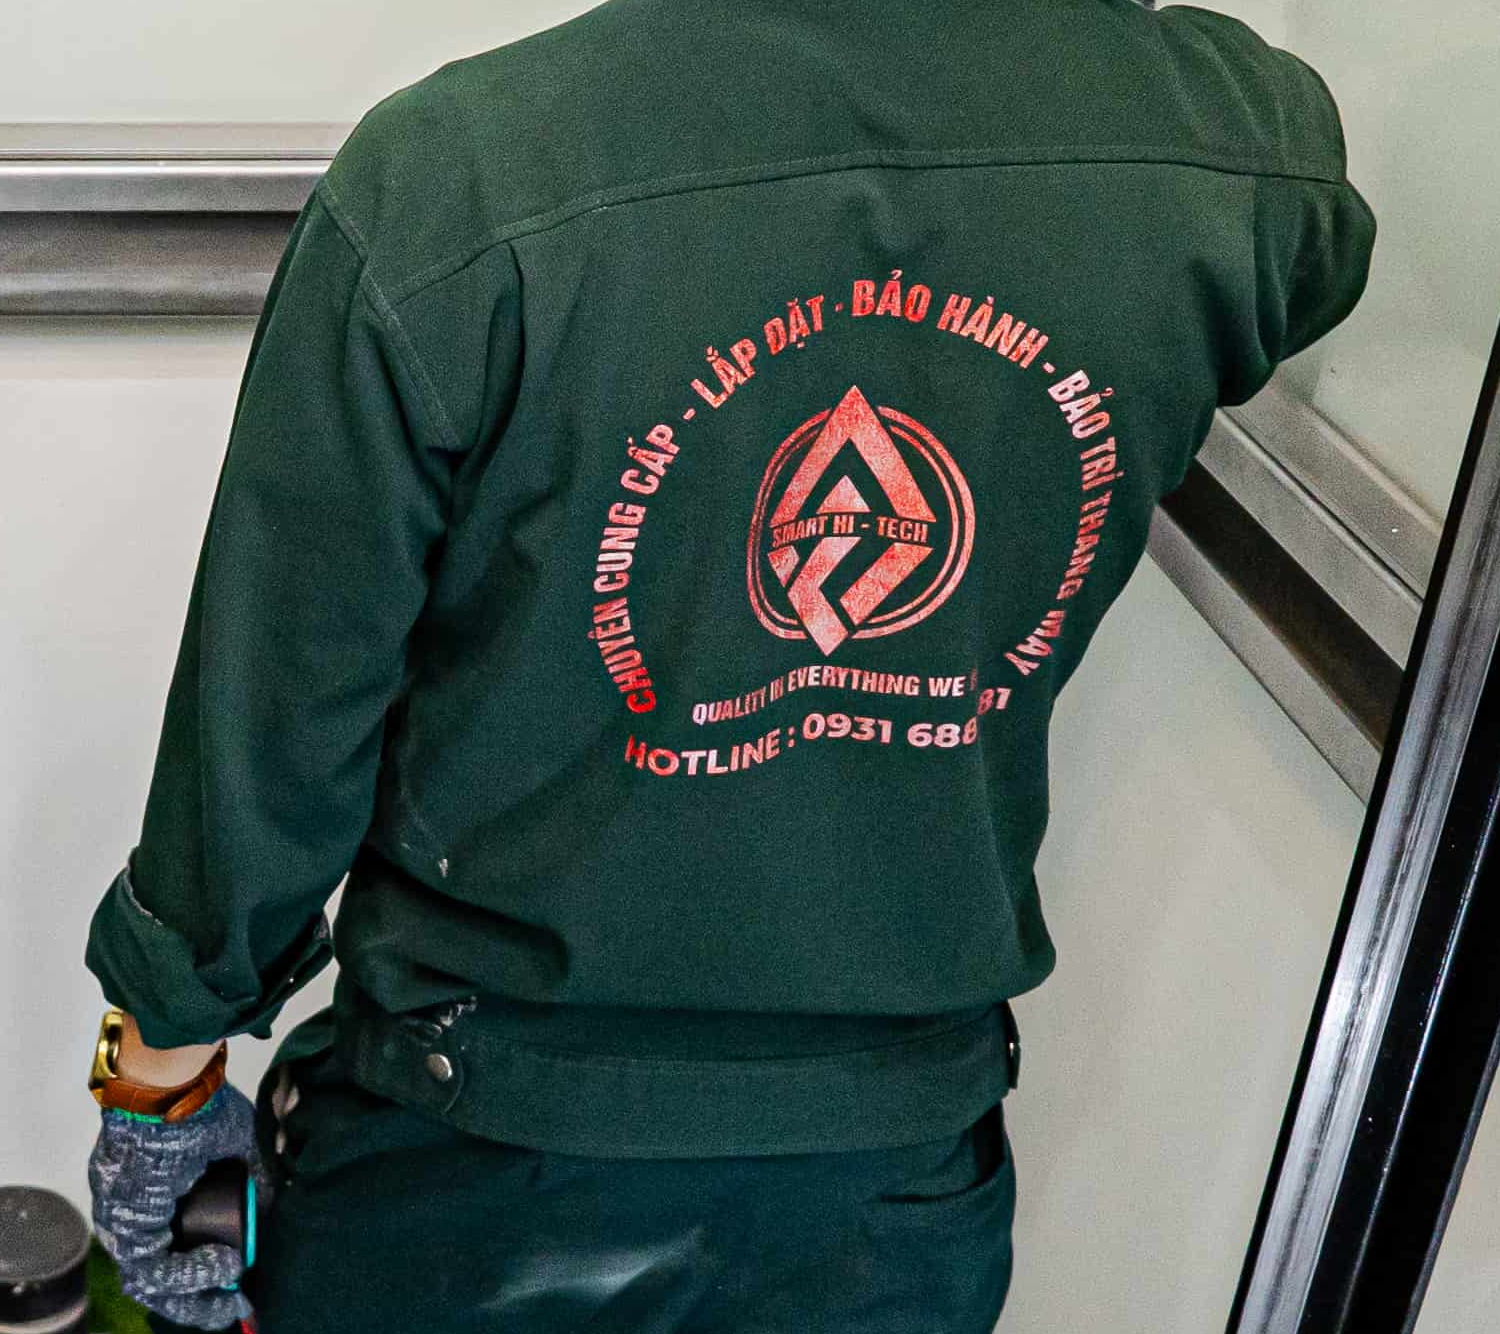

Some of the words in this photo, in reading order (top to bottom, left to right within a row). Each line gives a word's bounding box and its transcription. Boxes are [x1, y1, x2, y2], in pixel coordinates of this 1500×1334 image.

[593, 501, 646, 593] CUNG
[620, 423, 680, 496] CẤP
[690, 337, 758, 409] LẮP
[763, 294, 824, 357] ĐẶT
[852, 269, 932, 323] BẢO
[936, 294, 1049, 369] HÀNH
[1047, 369, 1114, 439] BẢO
[772, 516, 828, 548] SMART
[832, 514, 855, 535] HI
[876, 515, 929, 544] TECH
[692, 685, 766, 726] QUALITY
[786, 665, 921, 698] EVERYTHING
[928, 676, 967, 698] WE
[623, 730, 782, 777] HOTLINE
[802, 712, 894, 745] 0931
